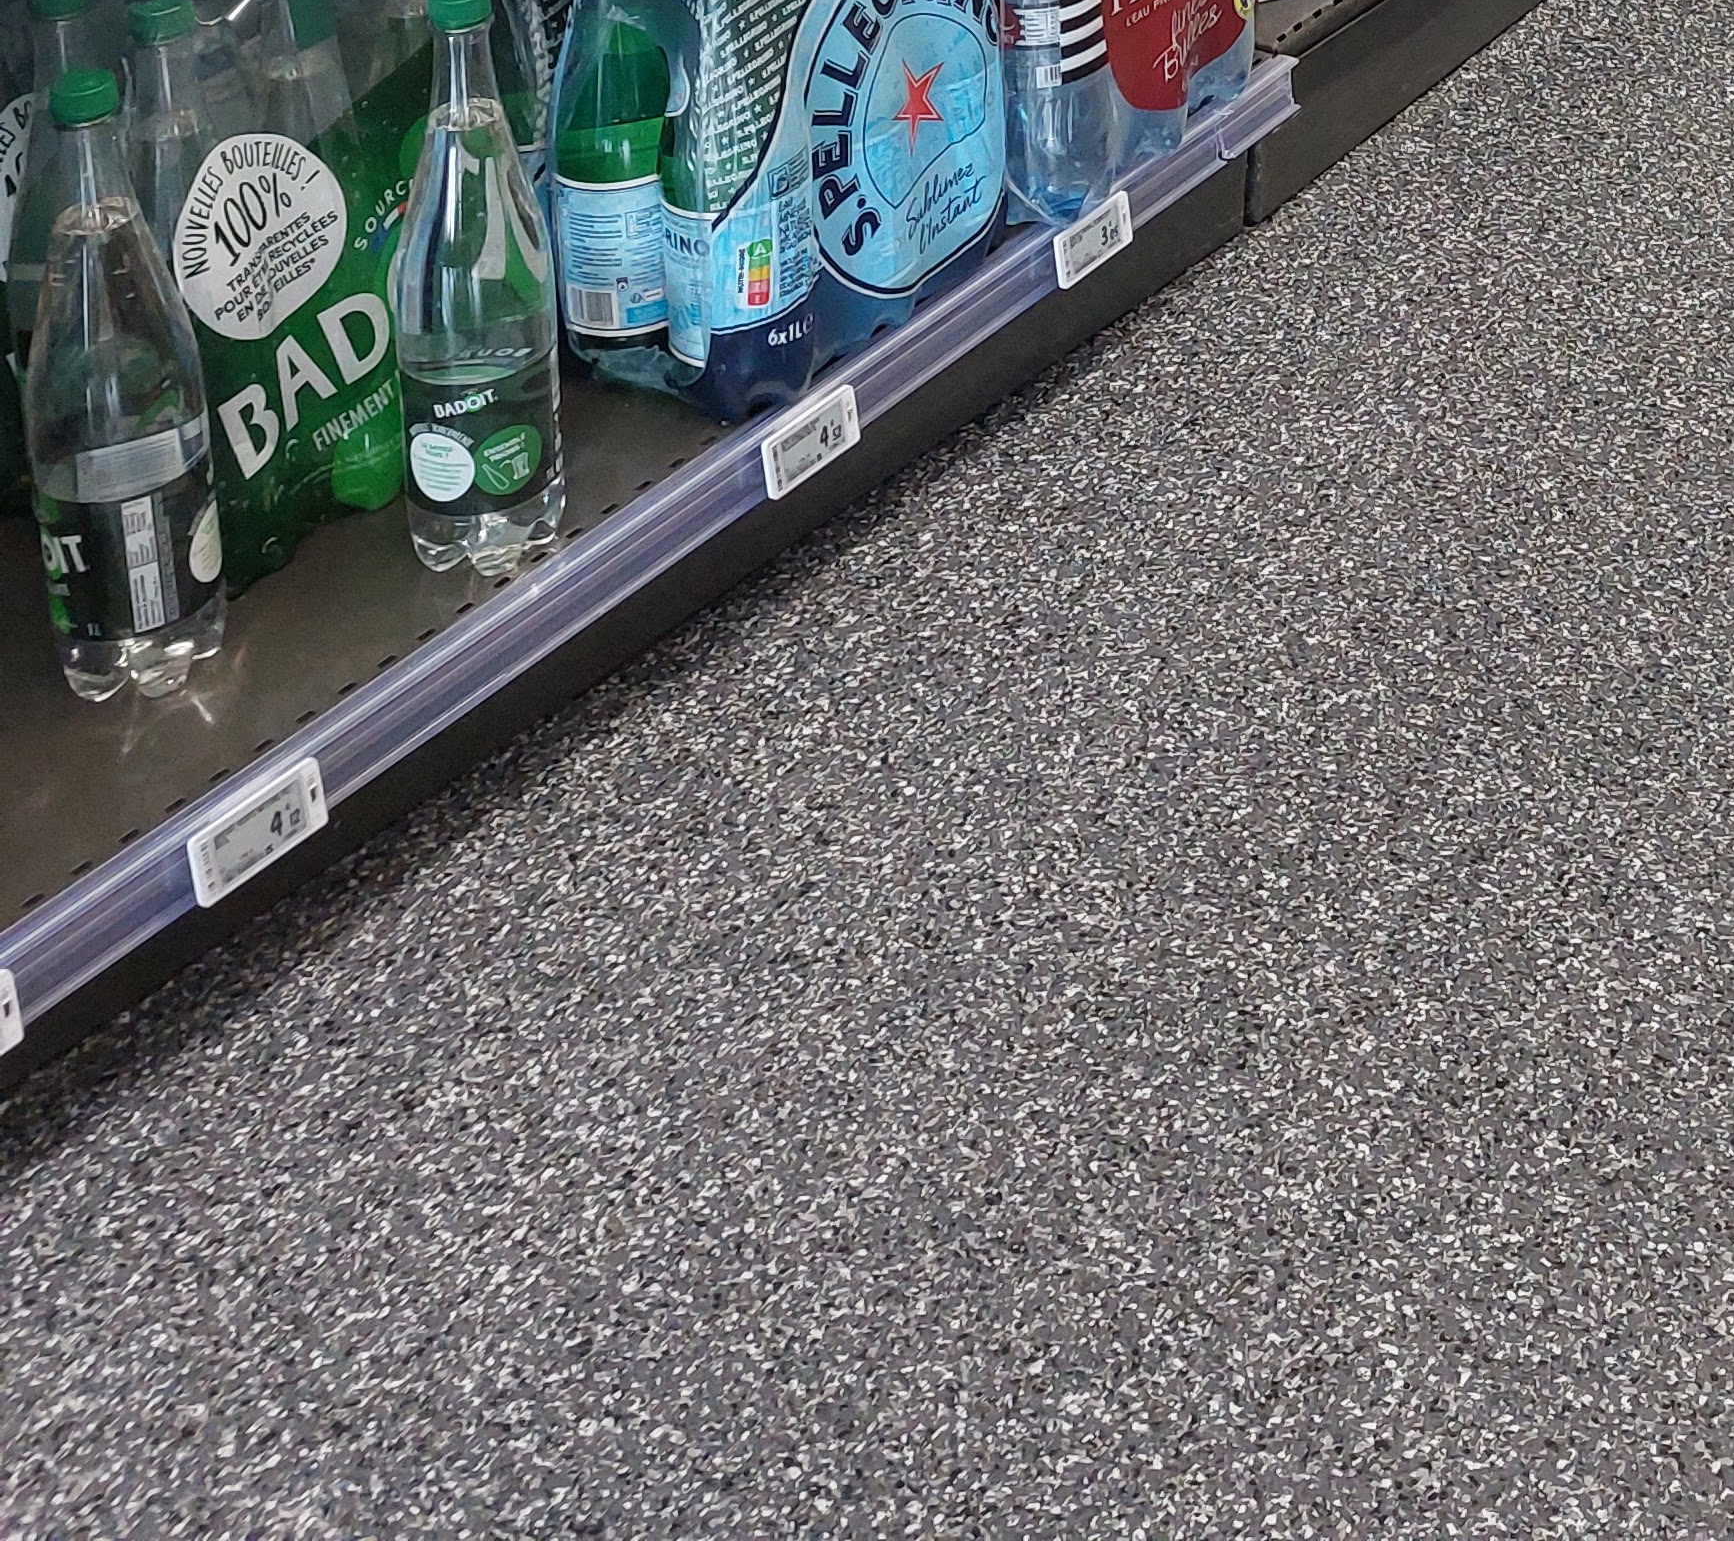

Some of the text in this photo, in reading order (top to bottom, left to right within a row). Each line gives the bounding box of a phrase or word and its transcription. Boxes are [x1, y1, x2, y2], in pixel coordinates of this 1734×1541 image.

[181, 140, 306, 280] NOUVELLES BOUTEILLES
[214, 172, 292, 267] 100%
[268, 210, 338, 261] RECYCLÉES
[311, 381, 397, 451] FINEMENT
[432, 387, 499, 419] BADOIT
